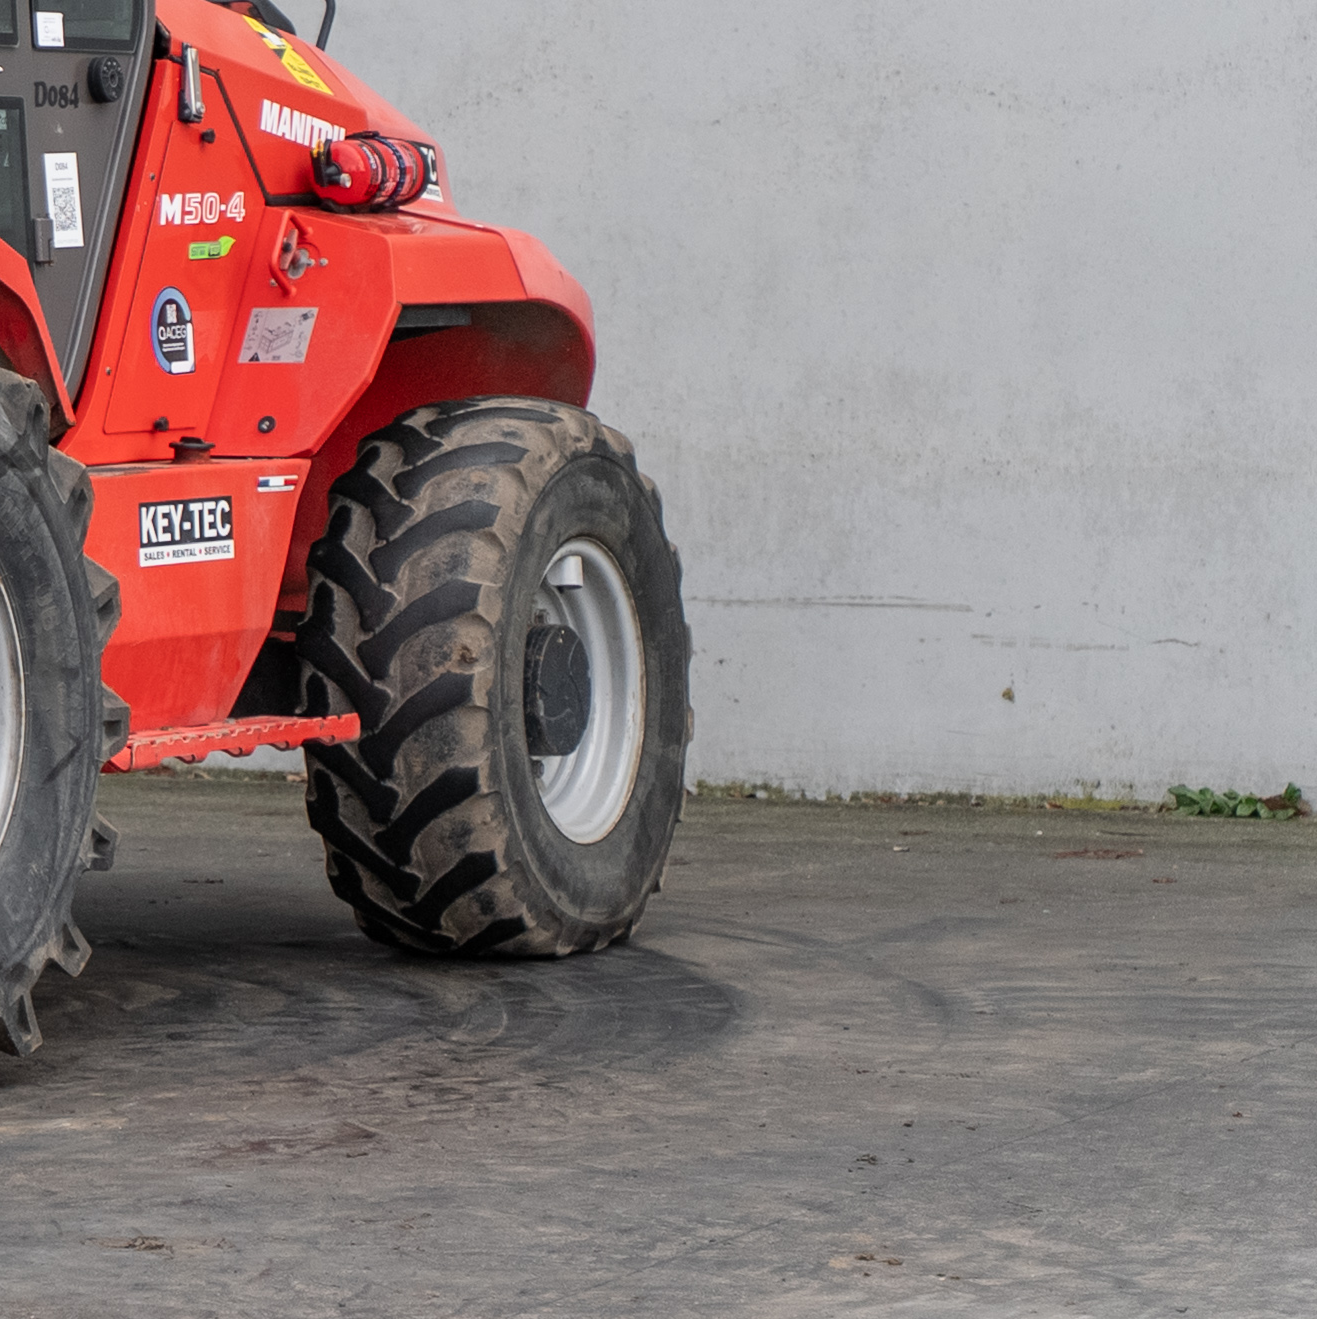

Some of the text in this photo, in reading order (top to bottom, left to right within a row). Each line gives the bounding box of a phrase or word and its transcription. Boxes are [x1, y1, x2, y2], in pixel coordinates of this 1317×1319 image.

[140, 499, 231, 544] KEY-TEC
[144, 544, 232, 562] SALES RENTAL SERVICE
